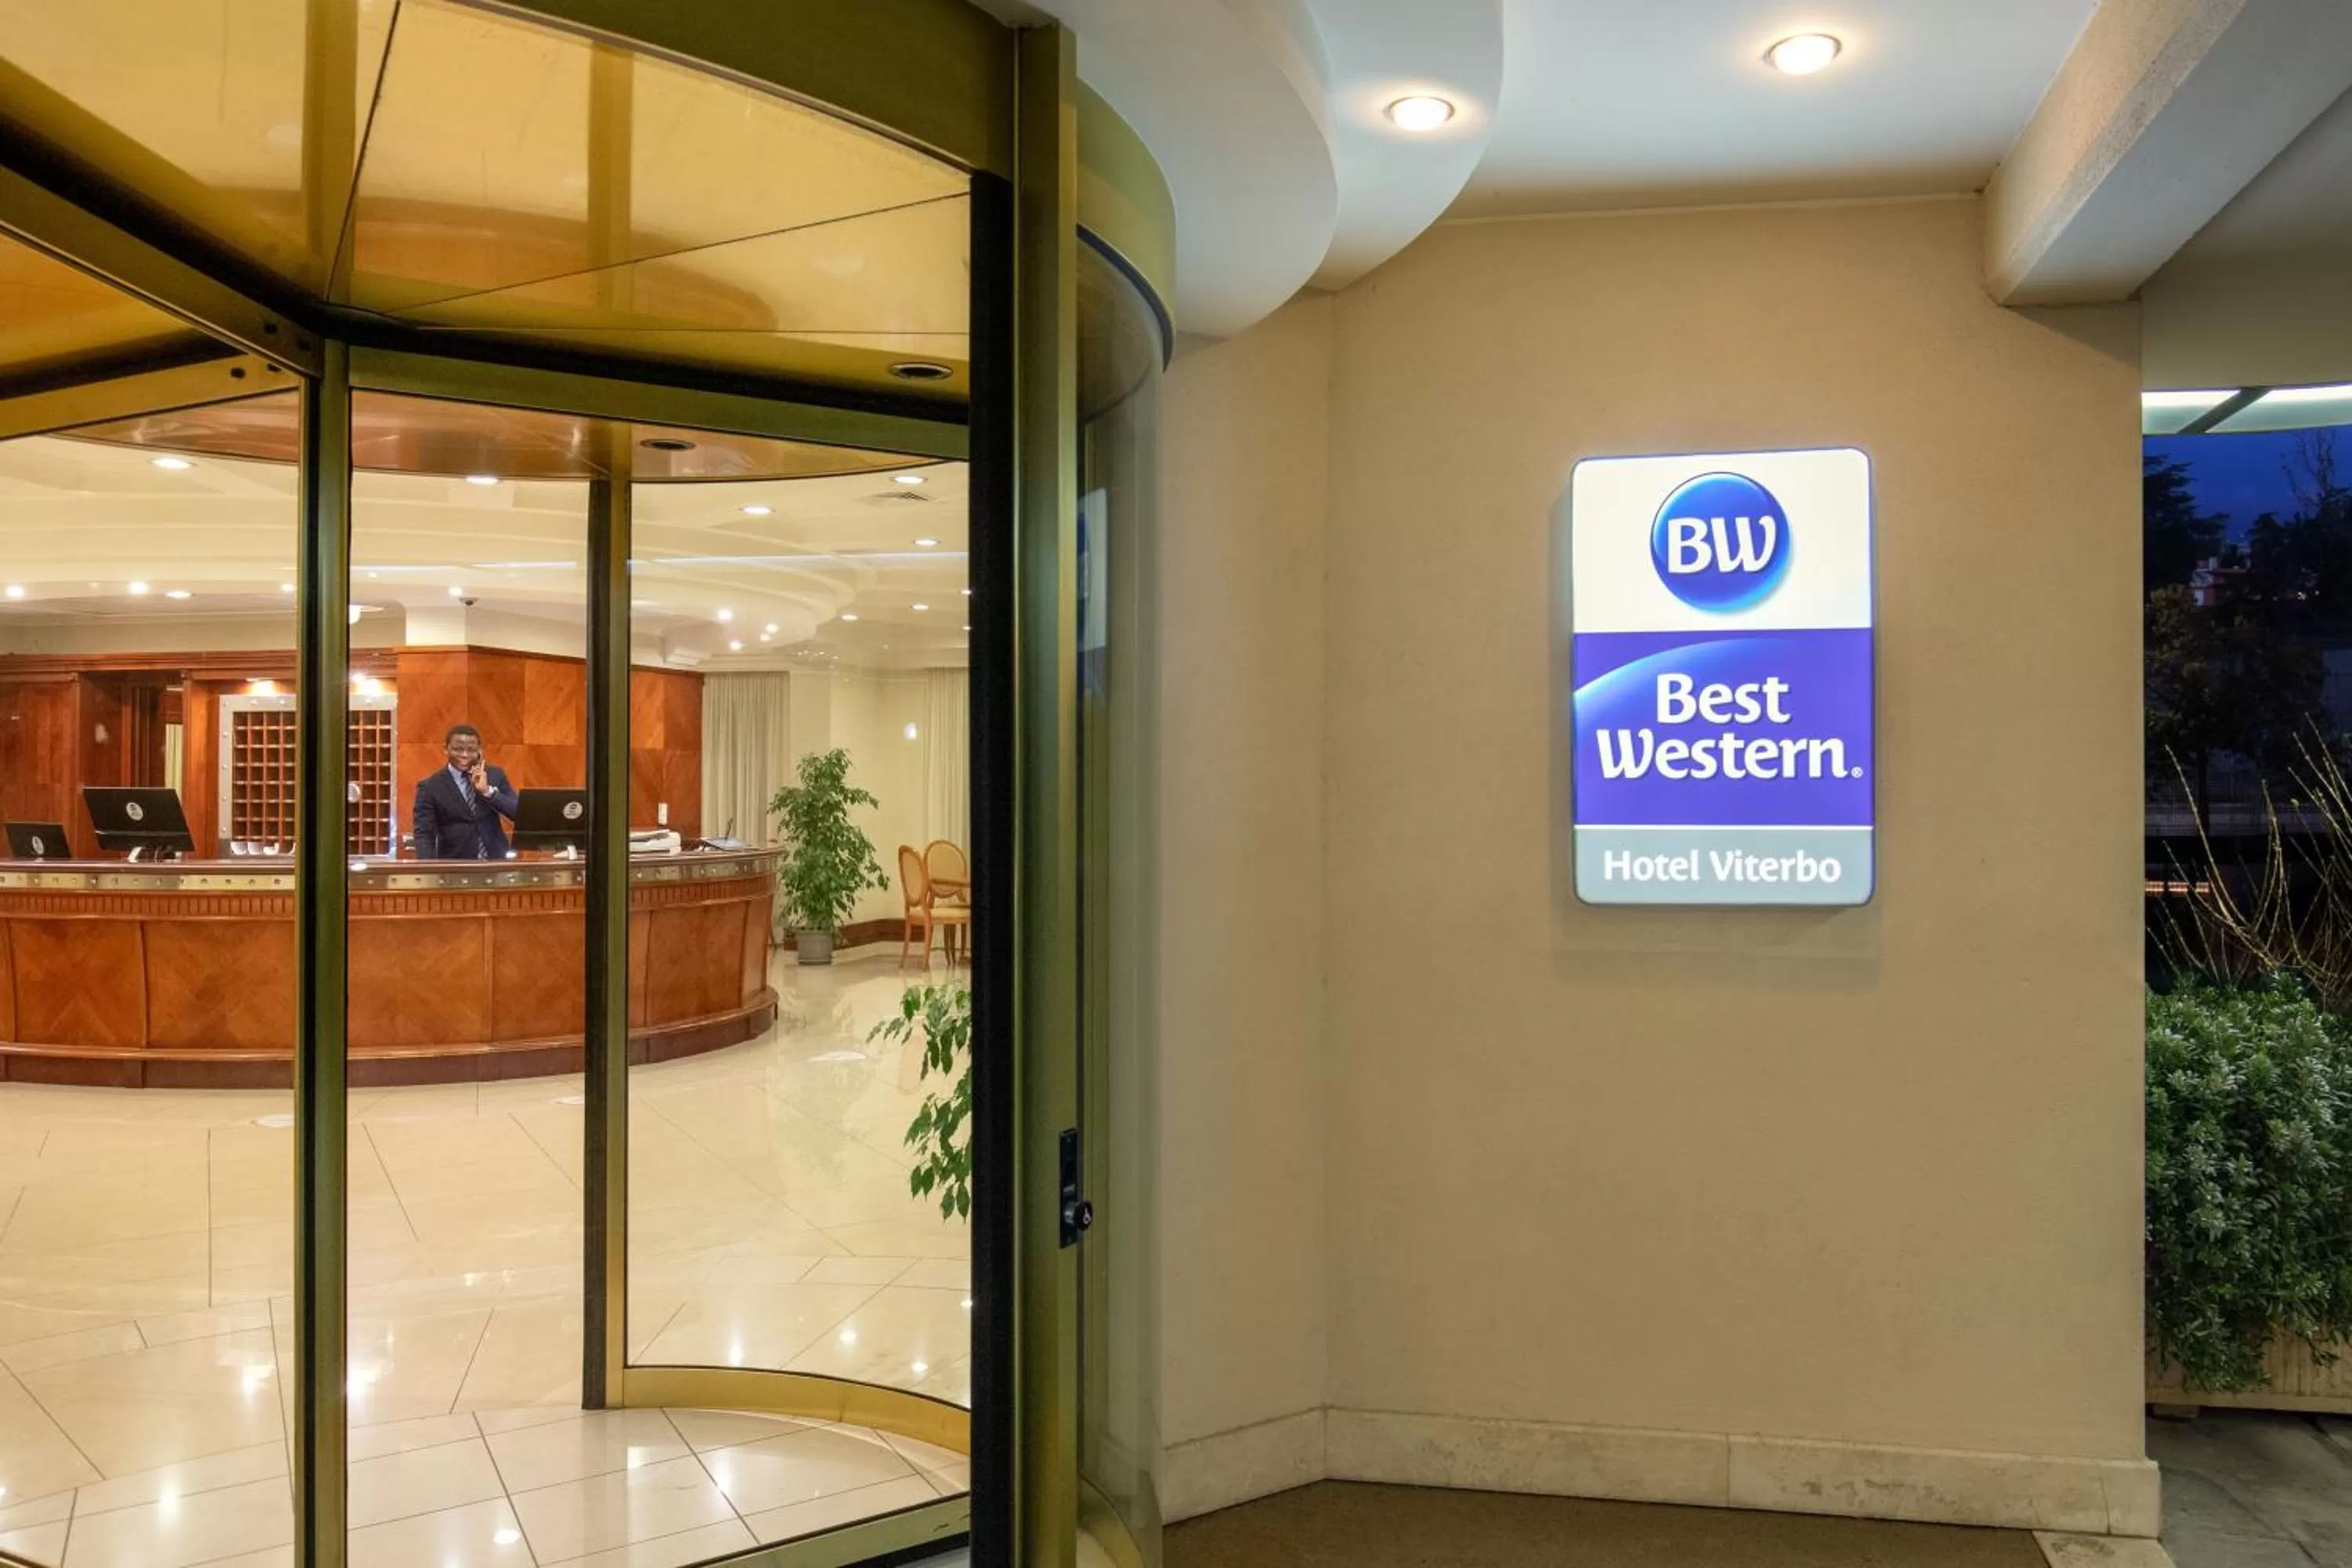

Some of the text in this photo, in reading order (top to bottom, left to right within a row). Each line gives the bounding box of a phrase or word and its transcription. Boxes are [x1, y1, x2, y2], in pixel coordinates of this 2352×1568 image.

[1668, 515, 1776, 573] BW
[1657, 673, 1791, 724] Best
[1604, 849, 1842, 883] Hotel Viterbo
